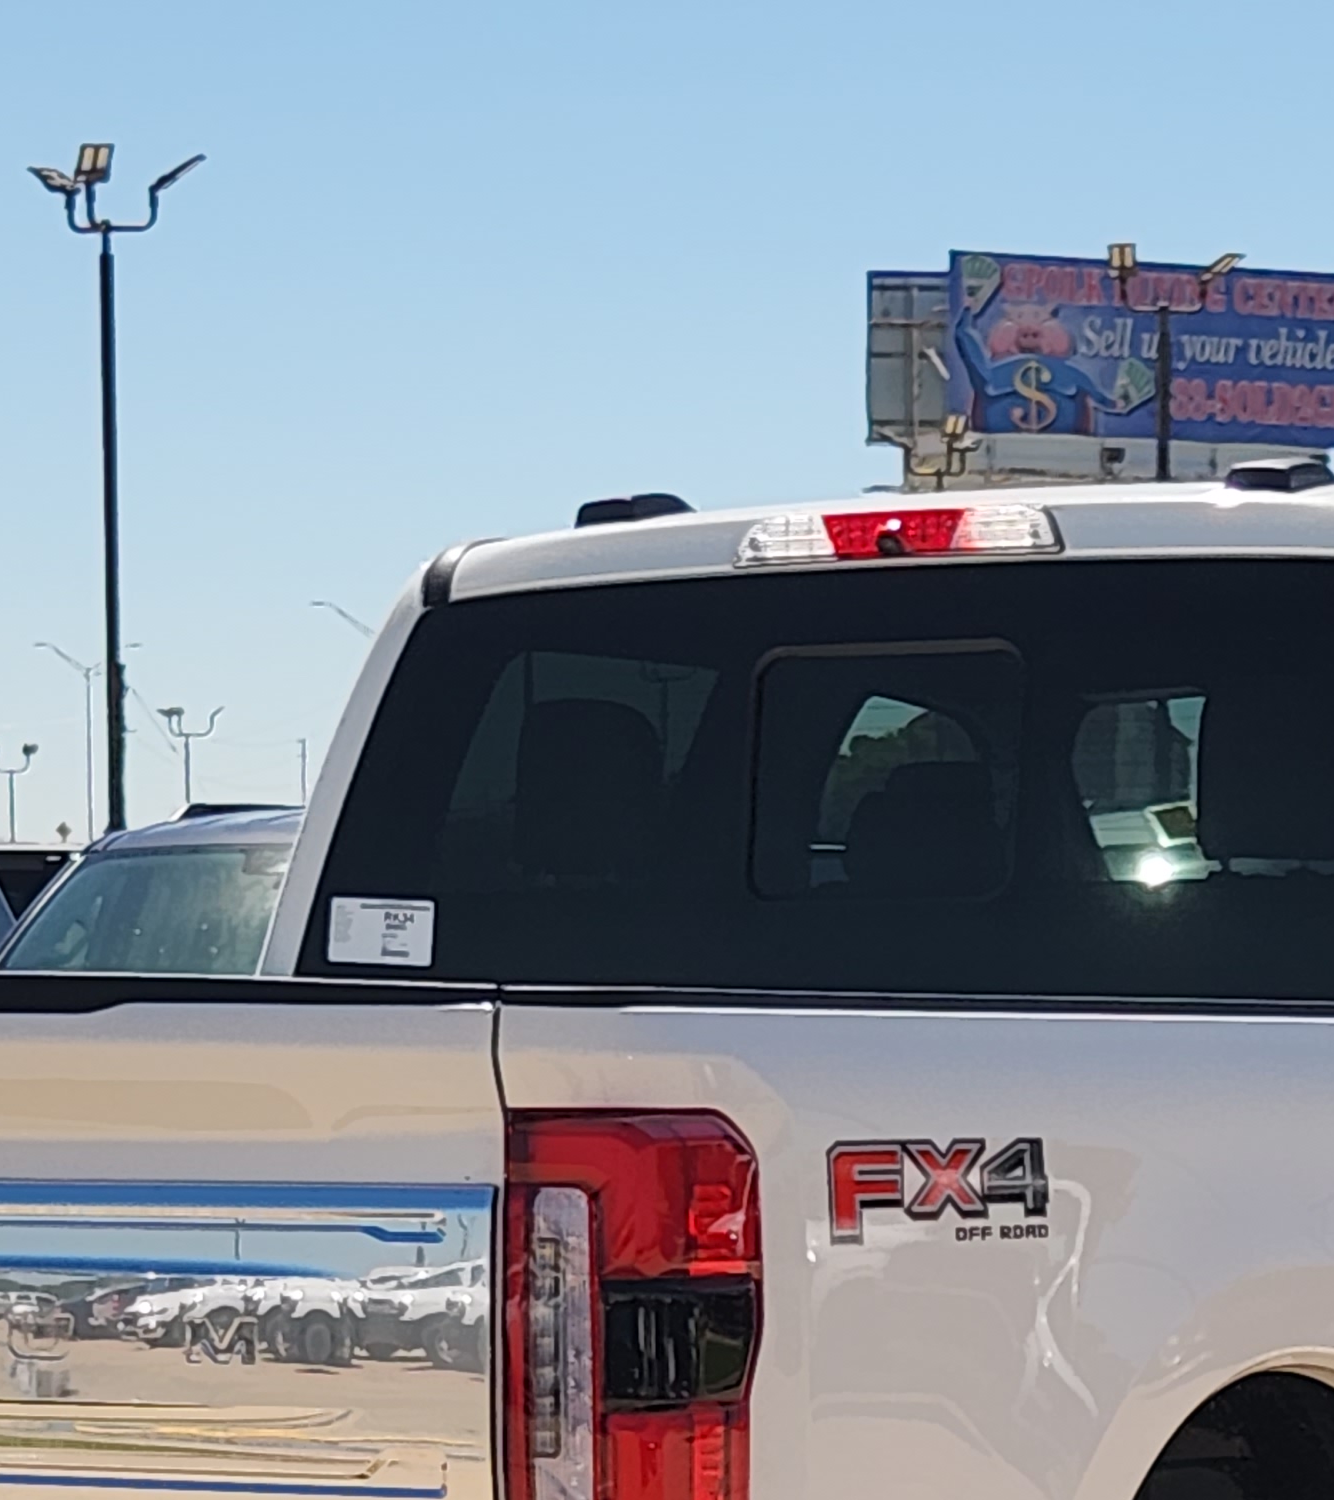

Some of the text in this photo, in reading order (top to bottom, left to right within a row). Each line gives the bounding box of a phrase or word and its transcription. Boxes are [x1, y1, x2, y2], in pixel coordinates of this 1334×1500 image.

[1076, 315, 1133, 360] Sell
[1175, 333, 1244, 371] your
[825, 1137, 1050, 1246] FX4
[954, 1224, 1049, 1242] OFF ROAD
